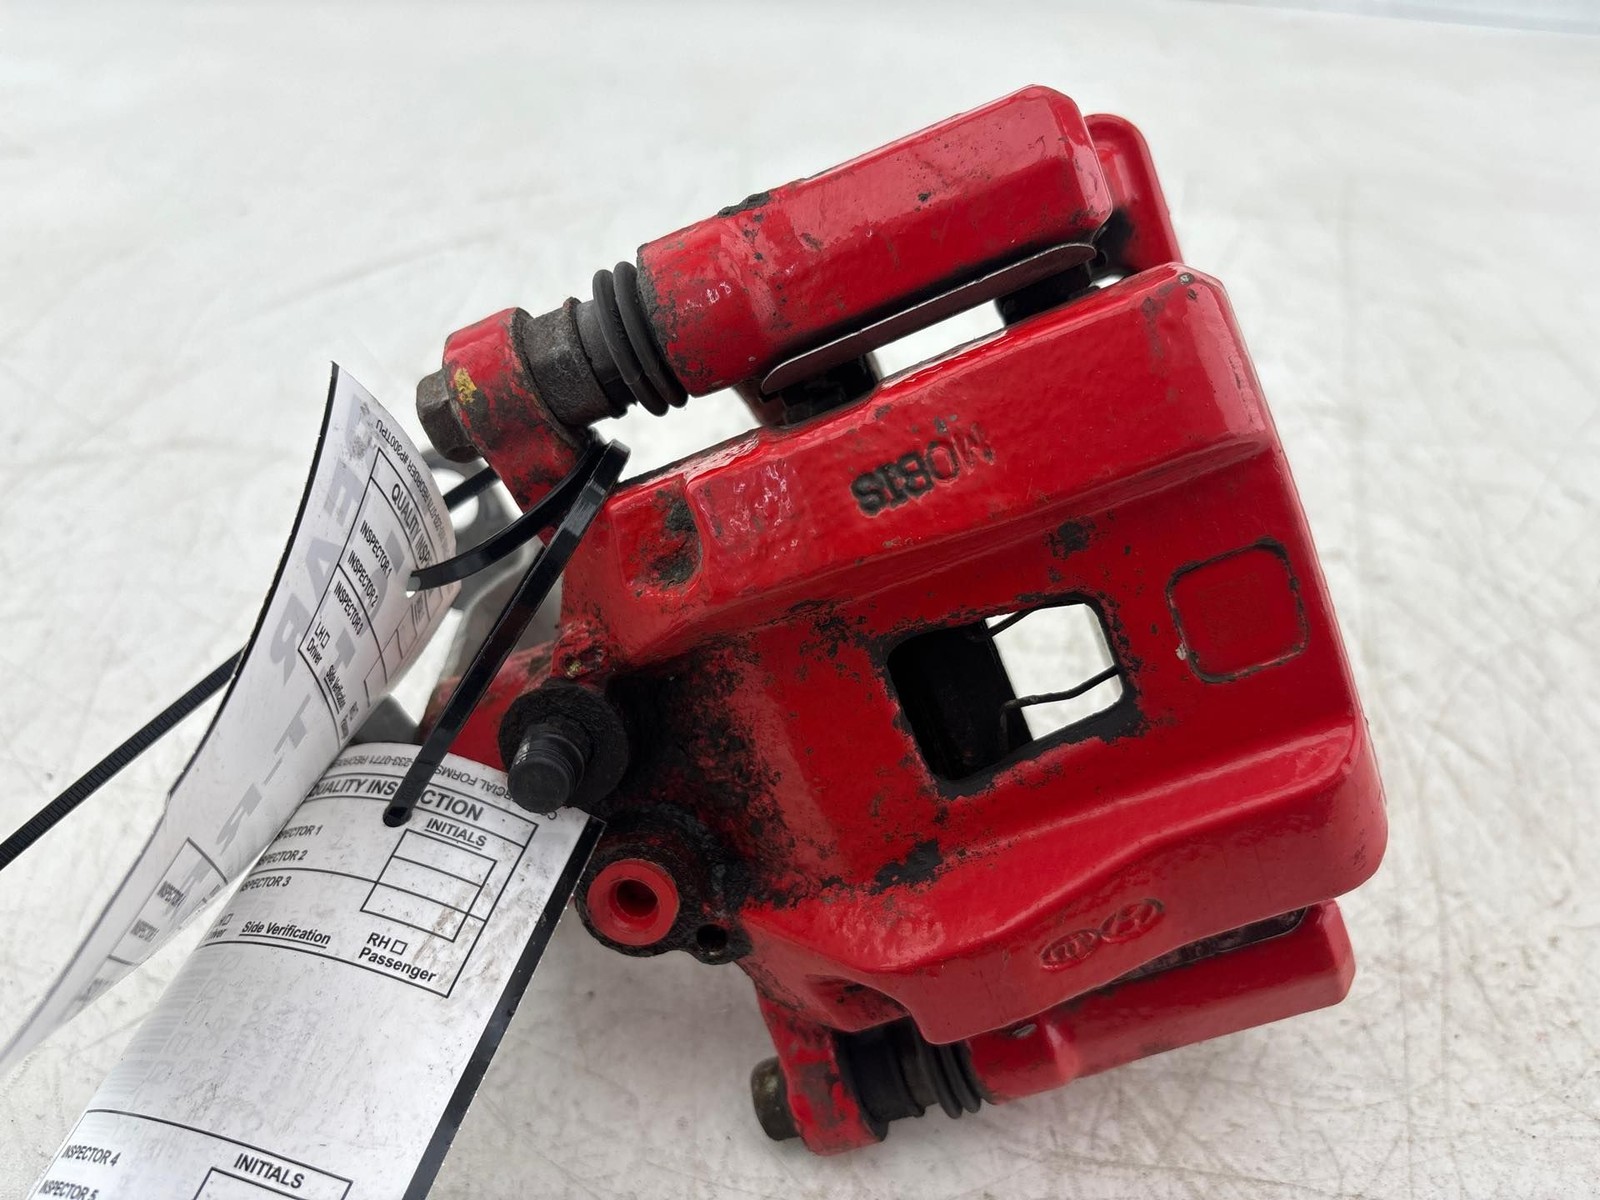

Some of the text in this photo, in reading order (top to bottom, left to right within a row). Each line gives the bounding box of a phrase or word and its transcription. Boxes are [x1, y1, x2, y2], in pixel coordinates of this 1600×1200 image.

[851, 423, 994, 517] MOBIS
[391, 483, 421, 544] QUALITY
[360, 519, 392, 580] INSPECTOR 1
[348, 549, 379, 608] INSPECTOR 2
[334, 580, 361, 632] INSPECTOR
[314, 621, 326, 641] LH
[306, 637, 322, 665] Driver
[432, 764, 476, 787] FORMS
[366, 778, 484, 822] INSCTION
[316, 825, 323, 836] 1
[426, 817, 487, 847] INITIALS
[297, 849, 308, 861] 2
[282, 875, 292, 887] 3
[241, 920, 265, 935] Side
[265, 921, 331, 945] Verification
[366, 932, 391, 950] RH
[358, 946, 437, 983] Passenger
[109, 1152, 121, 1168] 4
[233, 1152, 305, 1190] INITIALS
